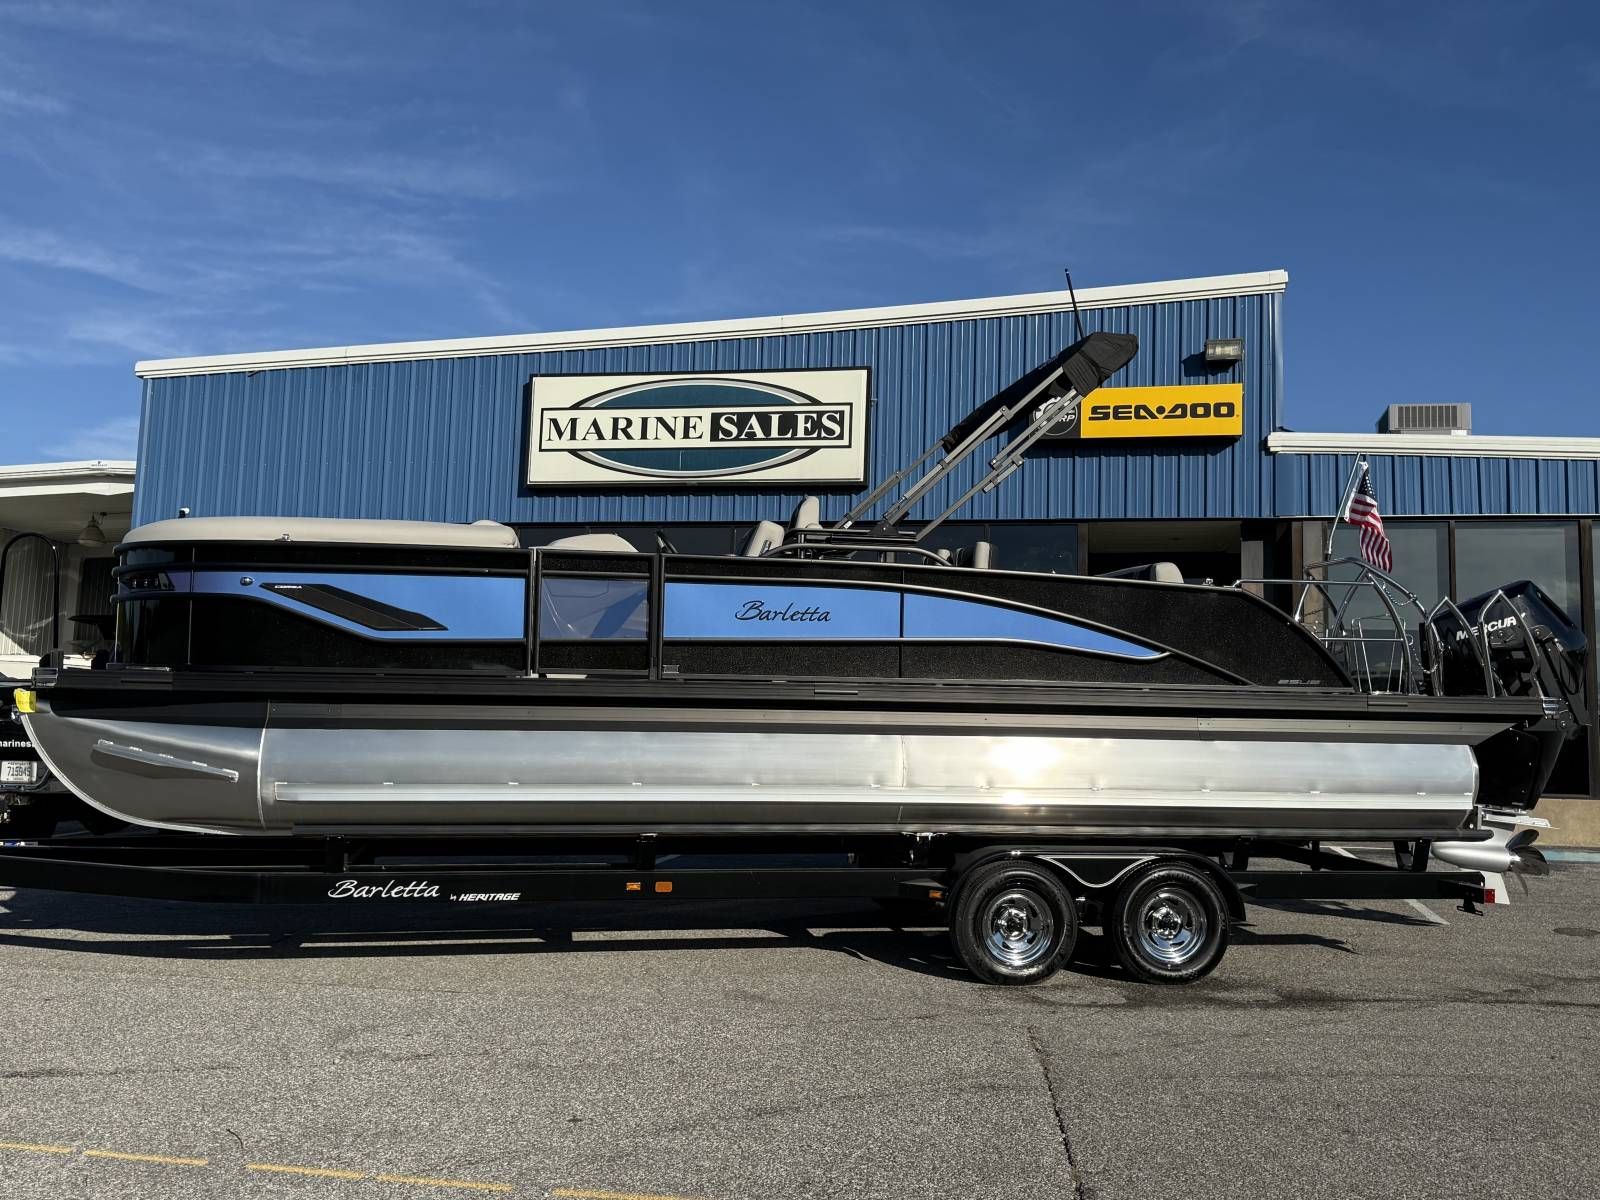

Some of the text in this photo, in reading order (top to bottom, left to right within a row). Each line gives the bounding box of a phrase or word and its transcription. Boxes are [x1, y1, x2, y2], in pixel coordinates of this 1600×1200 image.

[545, 411, 842, 442] MARINE SALES
[734, 600, 832, 622] Barletta
[327, 879, 440, 898] Barletta
[458, 892, 521, 902] HERITAGE
